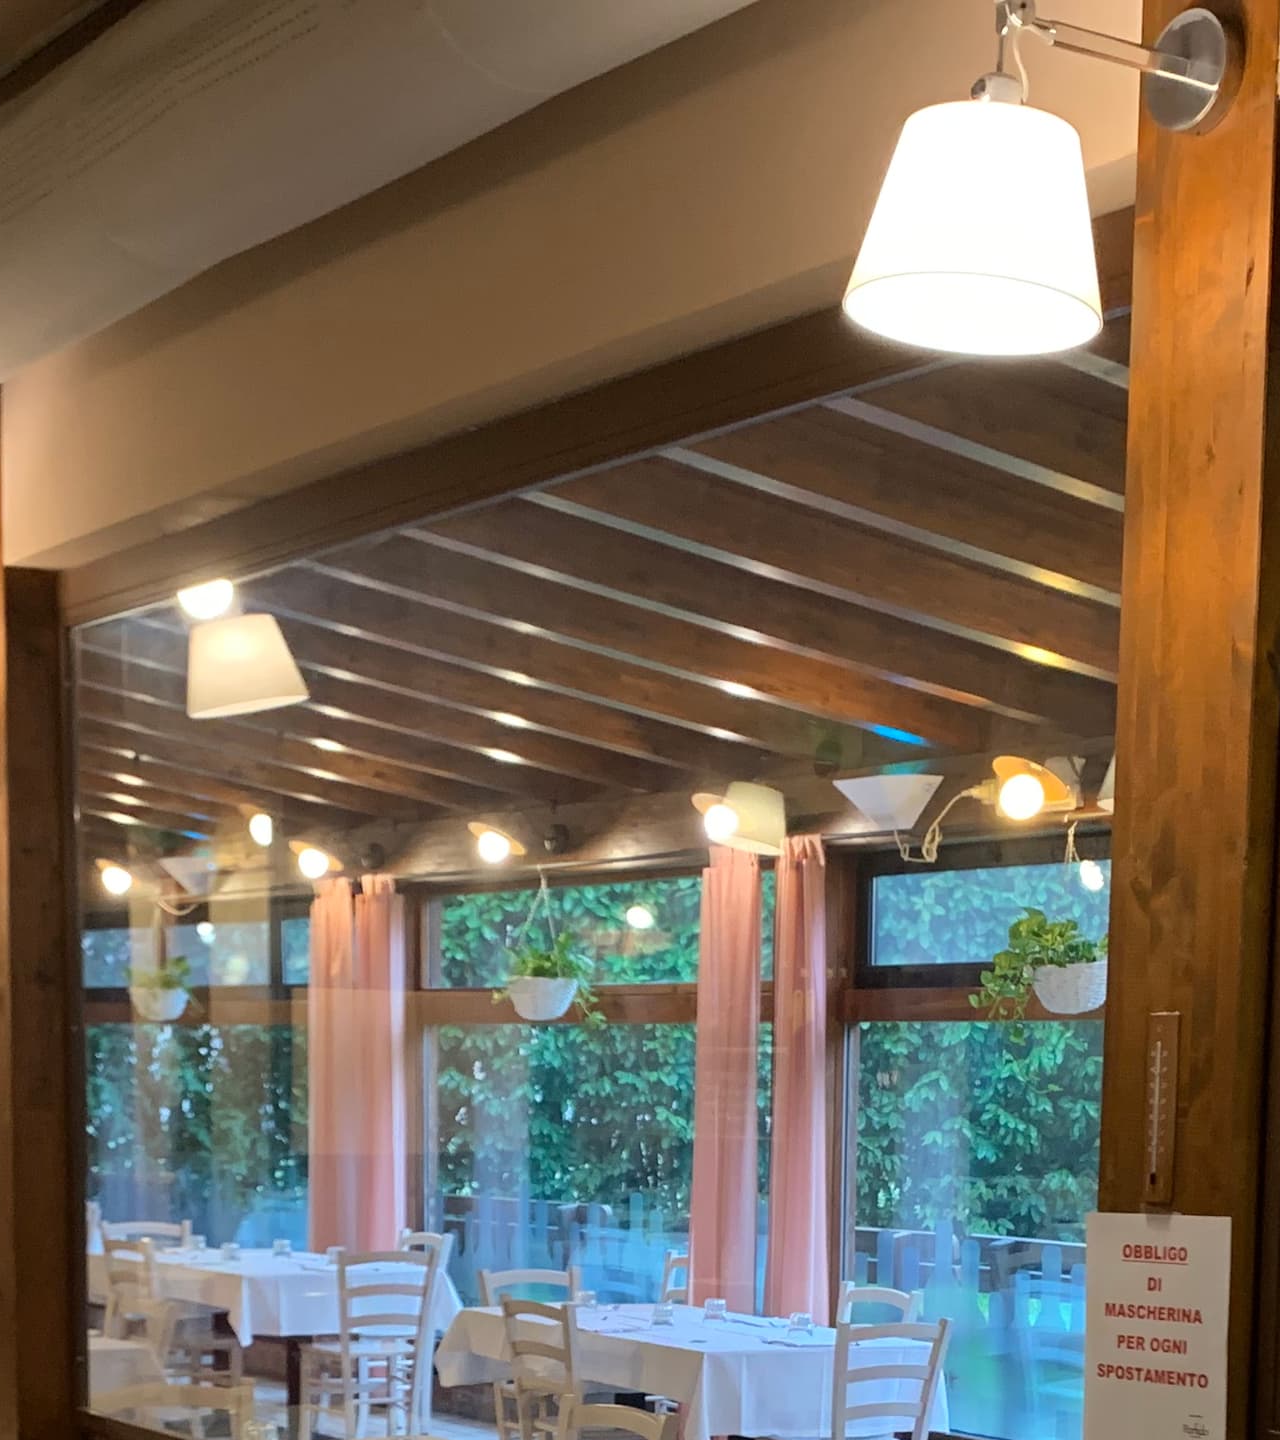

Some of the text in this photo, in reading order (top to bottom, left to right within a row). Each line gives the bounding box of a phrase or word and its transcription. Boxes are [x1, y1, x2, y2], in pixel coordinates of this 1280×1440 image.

[1122, 1243, 1188, 1262] OBBLIGO
[1147, 1276, 1162, 1292] DI
[1104, 1302, 1203, 1324] MASCHERINA
[1116, 1334, 1188, 1355] PER OGNI
[1097, 1362, 1209, 1389] SPOSTAMENTO
